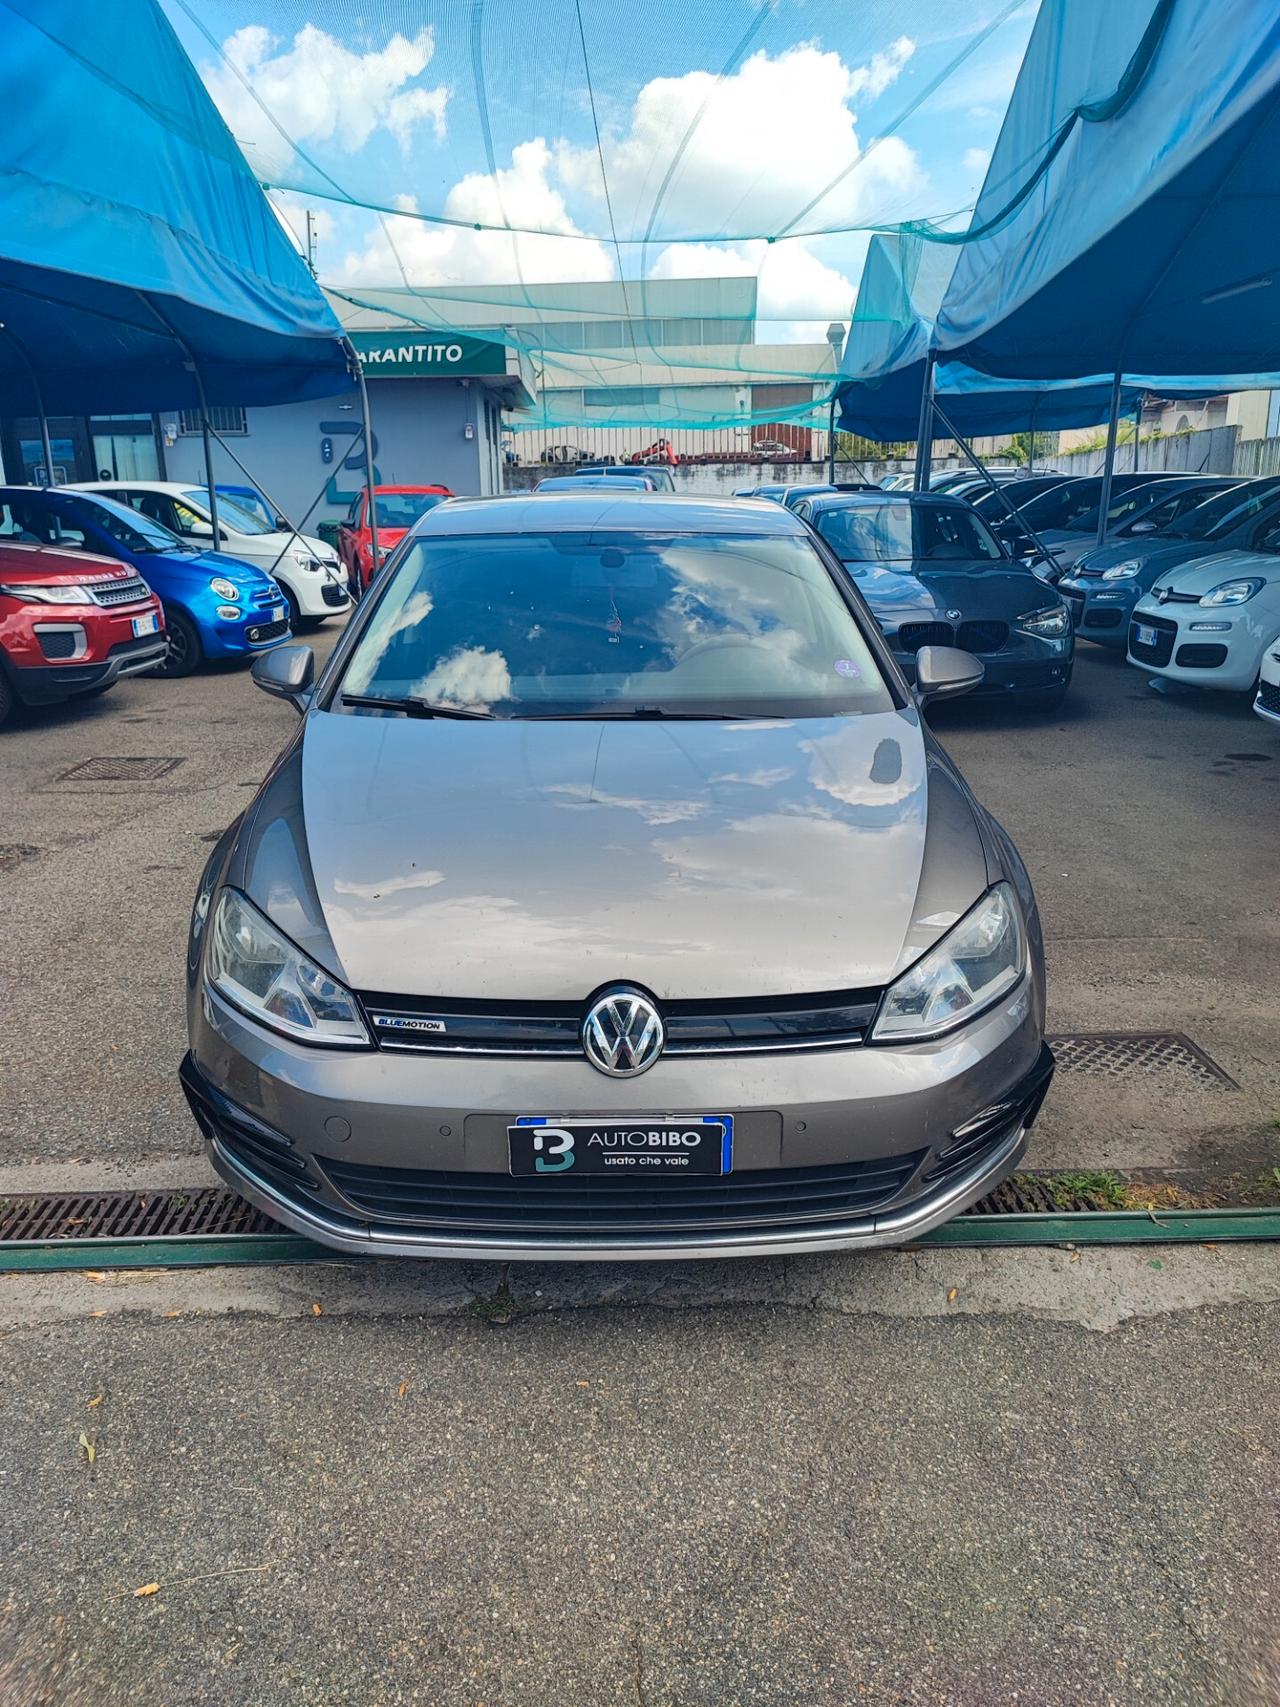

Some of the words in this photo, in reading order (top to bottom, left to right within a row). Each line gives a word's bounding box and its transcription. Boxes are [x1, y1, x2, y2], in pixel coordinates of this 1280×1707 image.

[378, 1018, 441, 1030] BLUEMOTION
[587, 1131, 702, 1147] AUTOBIBO
[604, 1156, 636, 1166] usato
[639, 1156, 662, 1166] che
[665, 1156, 690, 1166] vale
